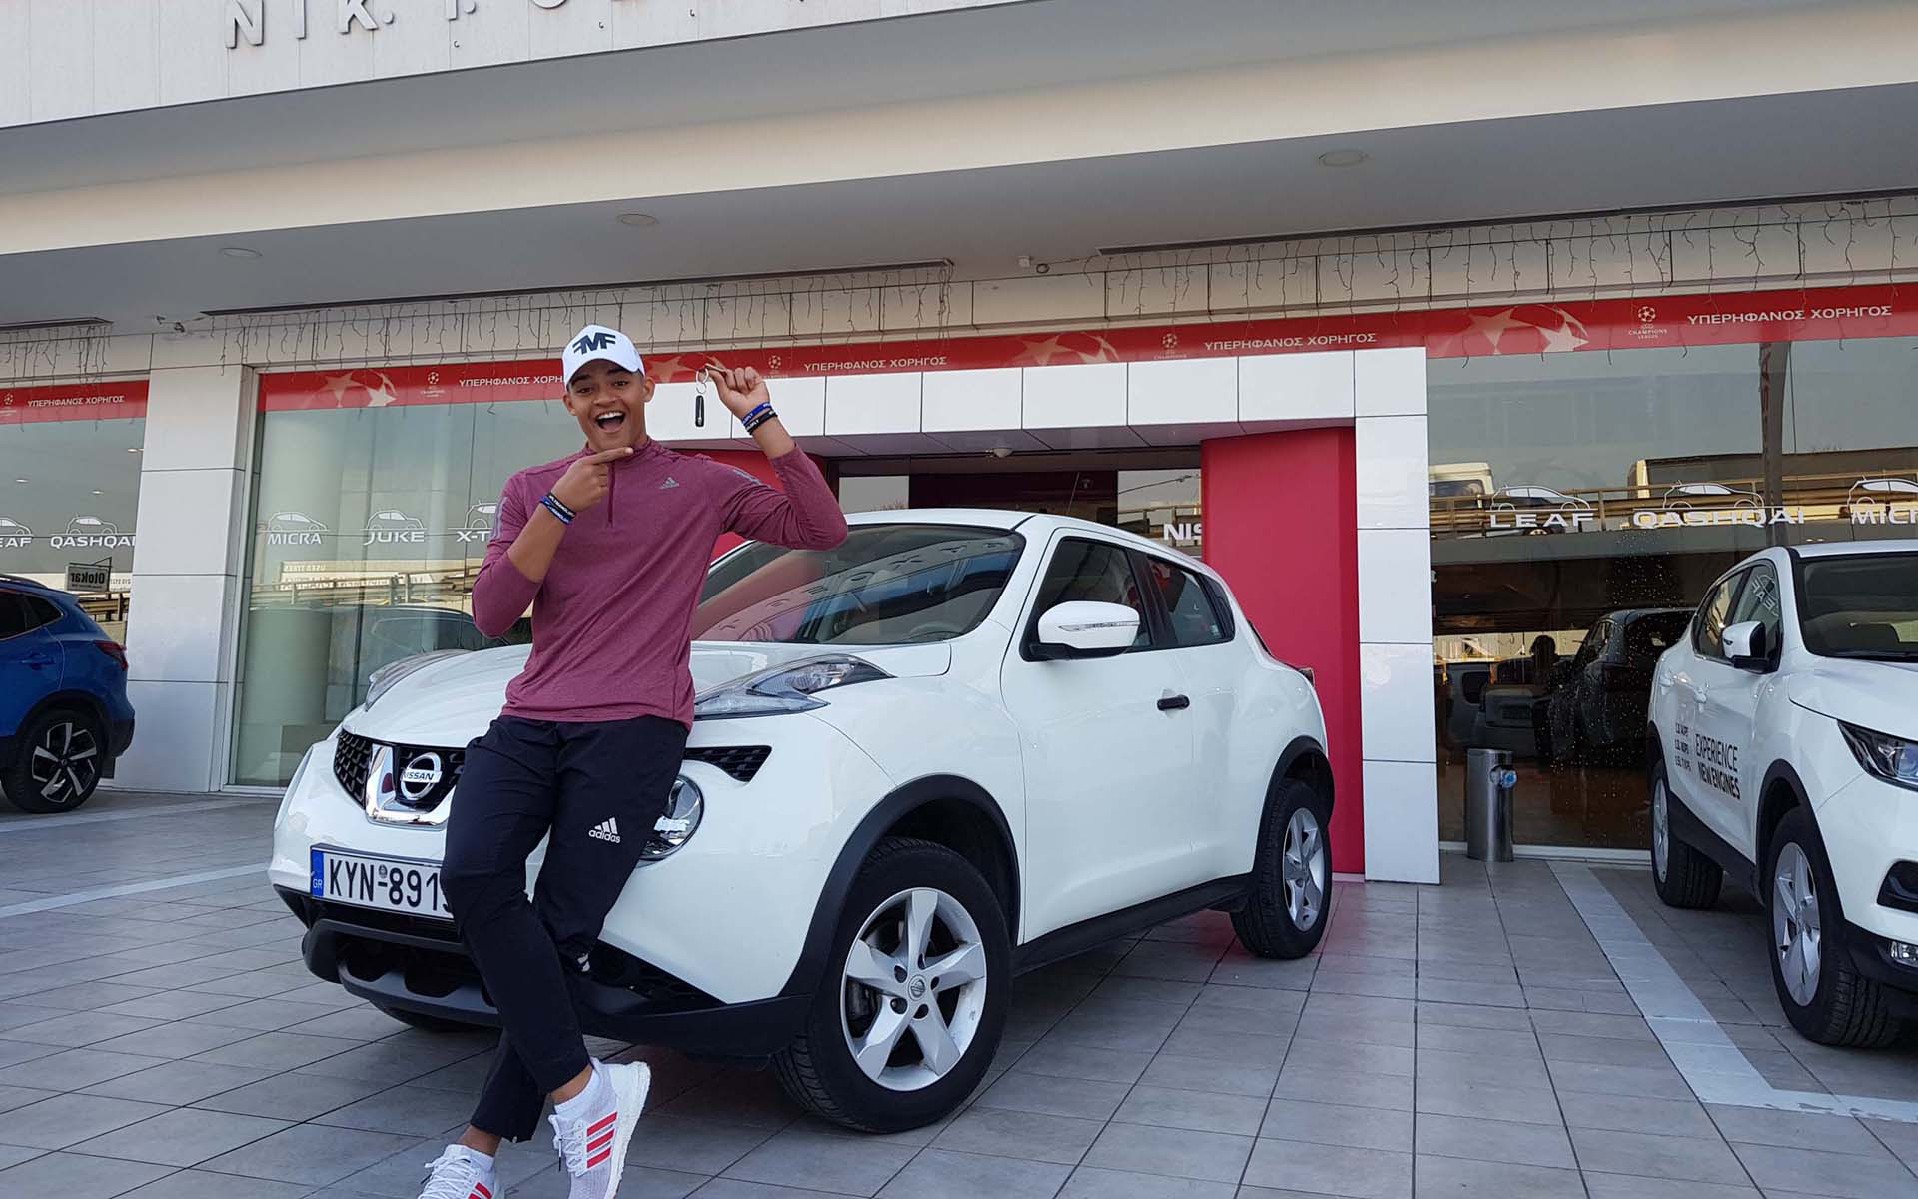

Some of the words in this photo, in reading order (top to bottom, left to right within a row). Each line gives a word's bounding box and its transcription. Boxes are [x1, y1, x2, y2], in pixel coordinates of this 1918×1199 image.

[1687, 309, 1805, 326] ΥΠΕΡΗΦΑΝΟΣ
[1810, 305, 1892, 319] ΧΟΡΗΓΟΣ
[1204, 336, 1304, 351] ΥΠΕΡΗΦΑΝΟΣ
[1307, 333, 1378, 346] ΧΟΡΗΓΟΣ
[804, 359, 887, 372] ΥΠΕΡΗΦΑΝΟΣ
[889, 356, 948, 368] ΧΟΡΗΓΟΣ
[459, 376, 531, 388] ΥΠΕΡΗΦΑΝΟΣ
[28, 398, 84, 408] ΥΠΕΡΗΦΑΝΟΣ
[85, 395, 125, 405] ΧΟΡΗΓΟΣ
[1489, 512, 1594, 528] LEAF
[1632, 509, 1806, 529] QASHQAI
[267, 532, 322, 545] MICRA
[362, 531, 426, 546] JUKE
[1695, 733, 1738, 772] EXPERIENCE
[588, 829, 621, 843] adidas
